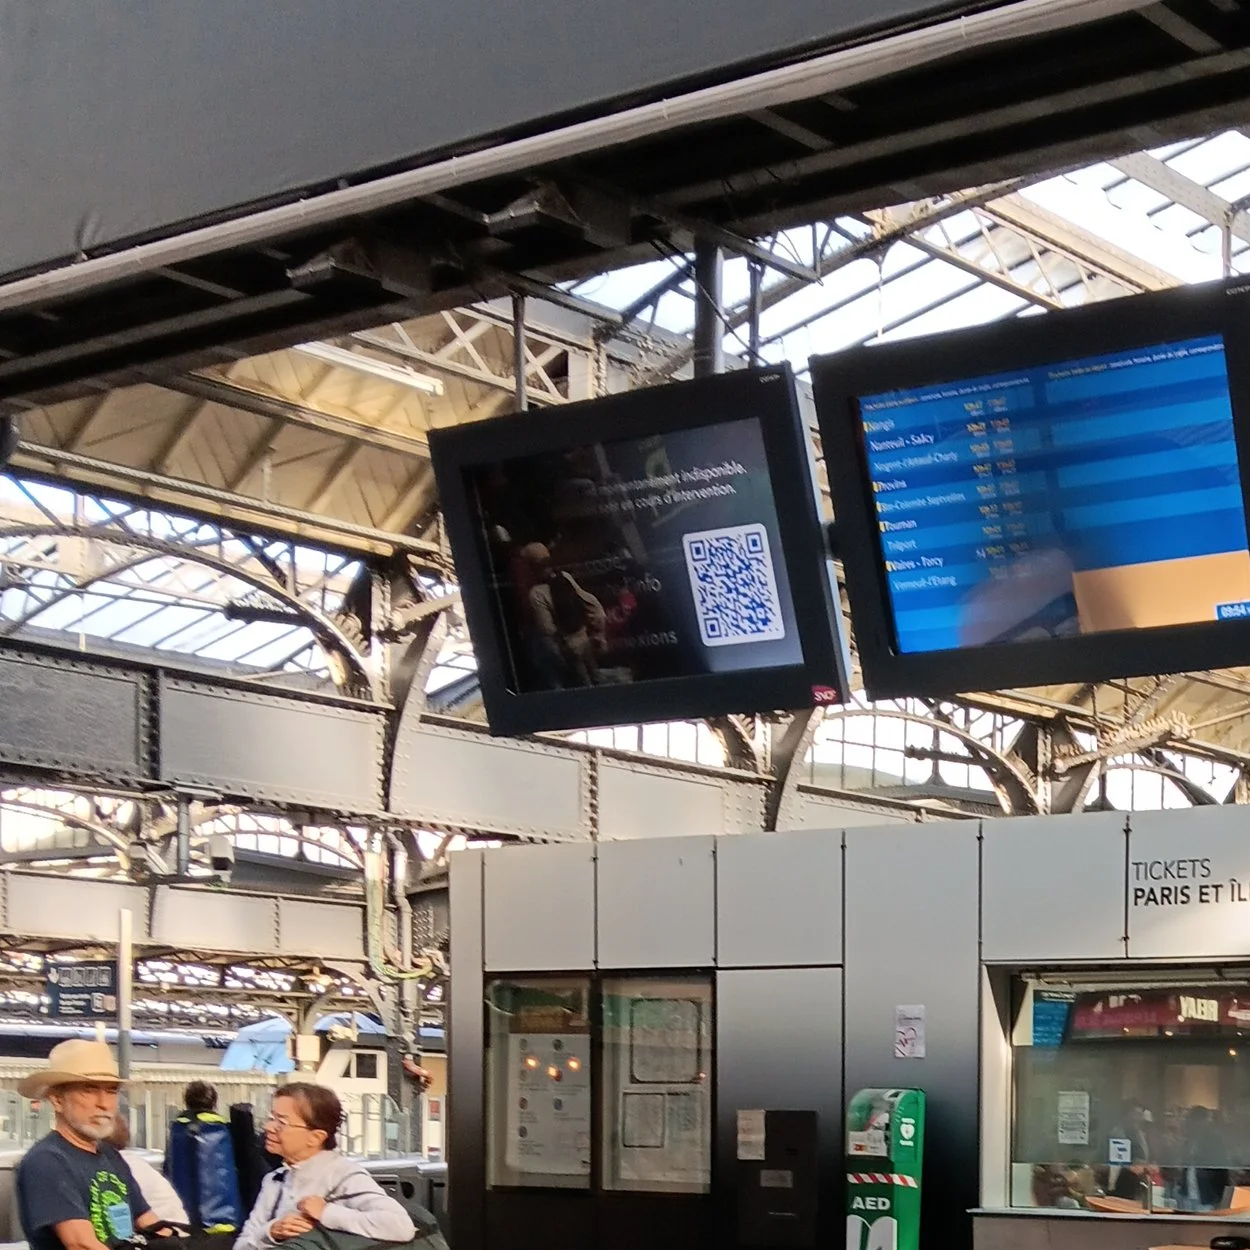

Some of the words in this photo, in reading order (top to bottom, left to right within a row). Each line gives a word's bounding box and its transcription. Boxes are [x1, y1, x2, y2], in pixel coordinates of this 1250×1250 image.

[813, 688, 838, 702] SNCF
[1132, 858, 1211, 881] TICKETS
[1133, 885, 1191, 907] PARIS
[1199, 884, 1225, 904] ET
[852, 1196, 891, 1211] AED
